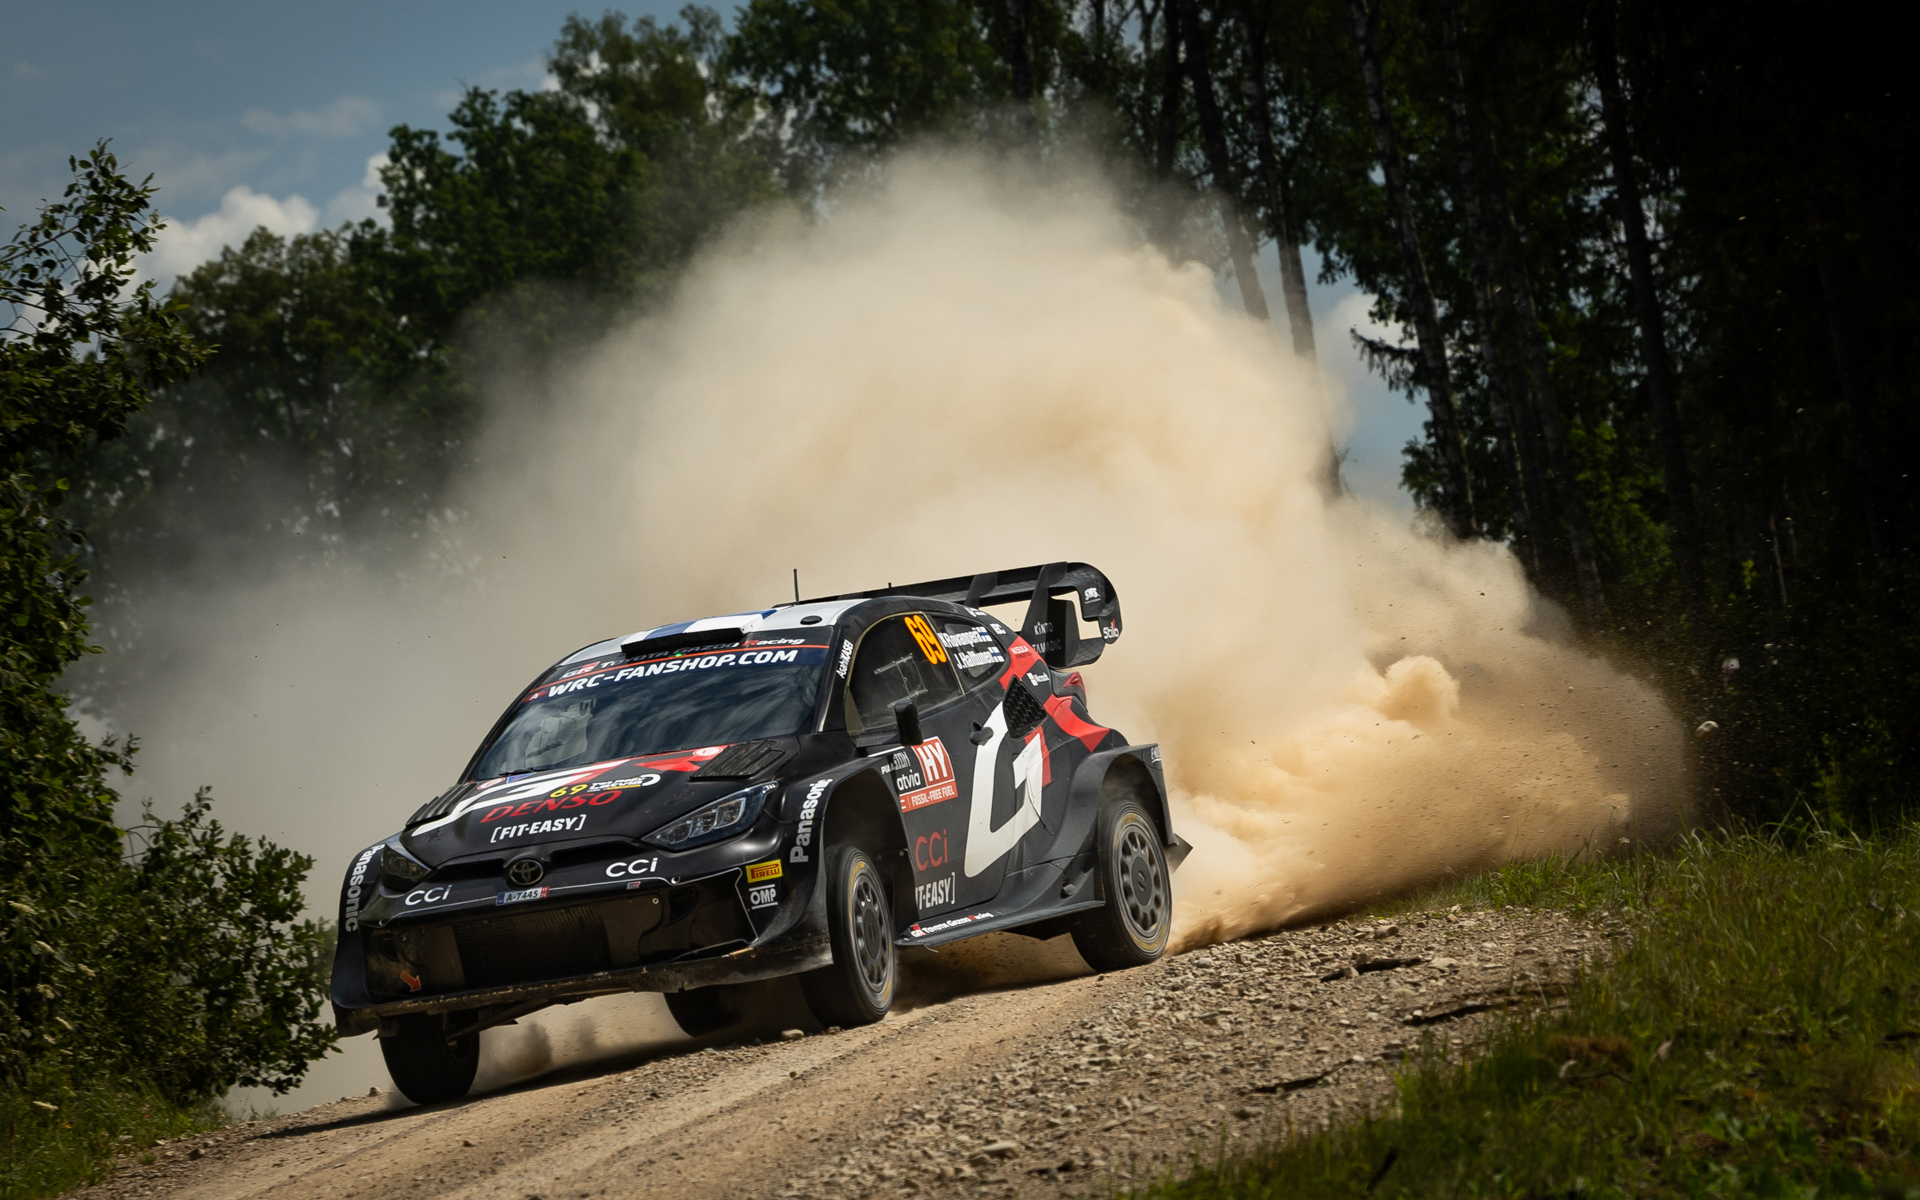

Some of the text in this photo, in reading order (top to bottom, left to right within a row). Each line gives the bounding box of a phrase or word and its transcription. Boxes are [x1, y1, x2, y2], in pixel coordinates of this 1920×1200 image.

[904, 614, 947, 665] 69
[1102, 619, 1119, 639] Stilo
[742, 638, 805, 648] Racing
[547, 650, 798, 698] WRC-FANSHOP.COM
[916, 741, 948, 782] HY
[550, 784, 587, 798] 69
[896, 768, 921, 791] atvia
[479, 790, 622, 824] DENSO
[911, 788, 942, 806] FOSSIL-FREE
[942, 785, 955, 798] FUEL
[490, 813, 587, 843] [FIT-EASY]
[789, 778, 833, 864] Panasonic
[750, 863, 779, 880] PIRELLI
[345, 843, 386, 932] Panasonic
[506, 889, 539, 902] A-7445
[750, 887, 777, 906] OMP
